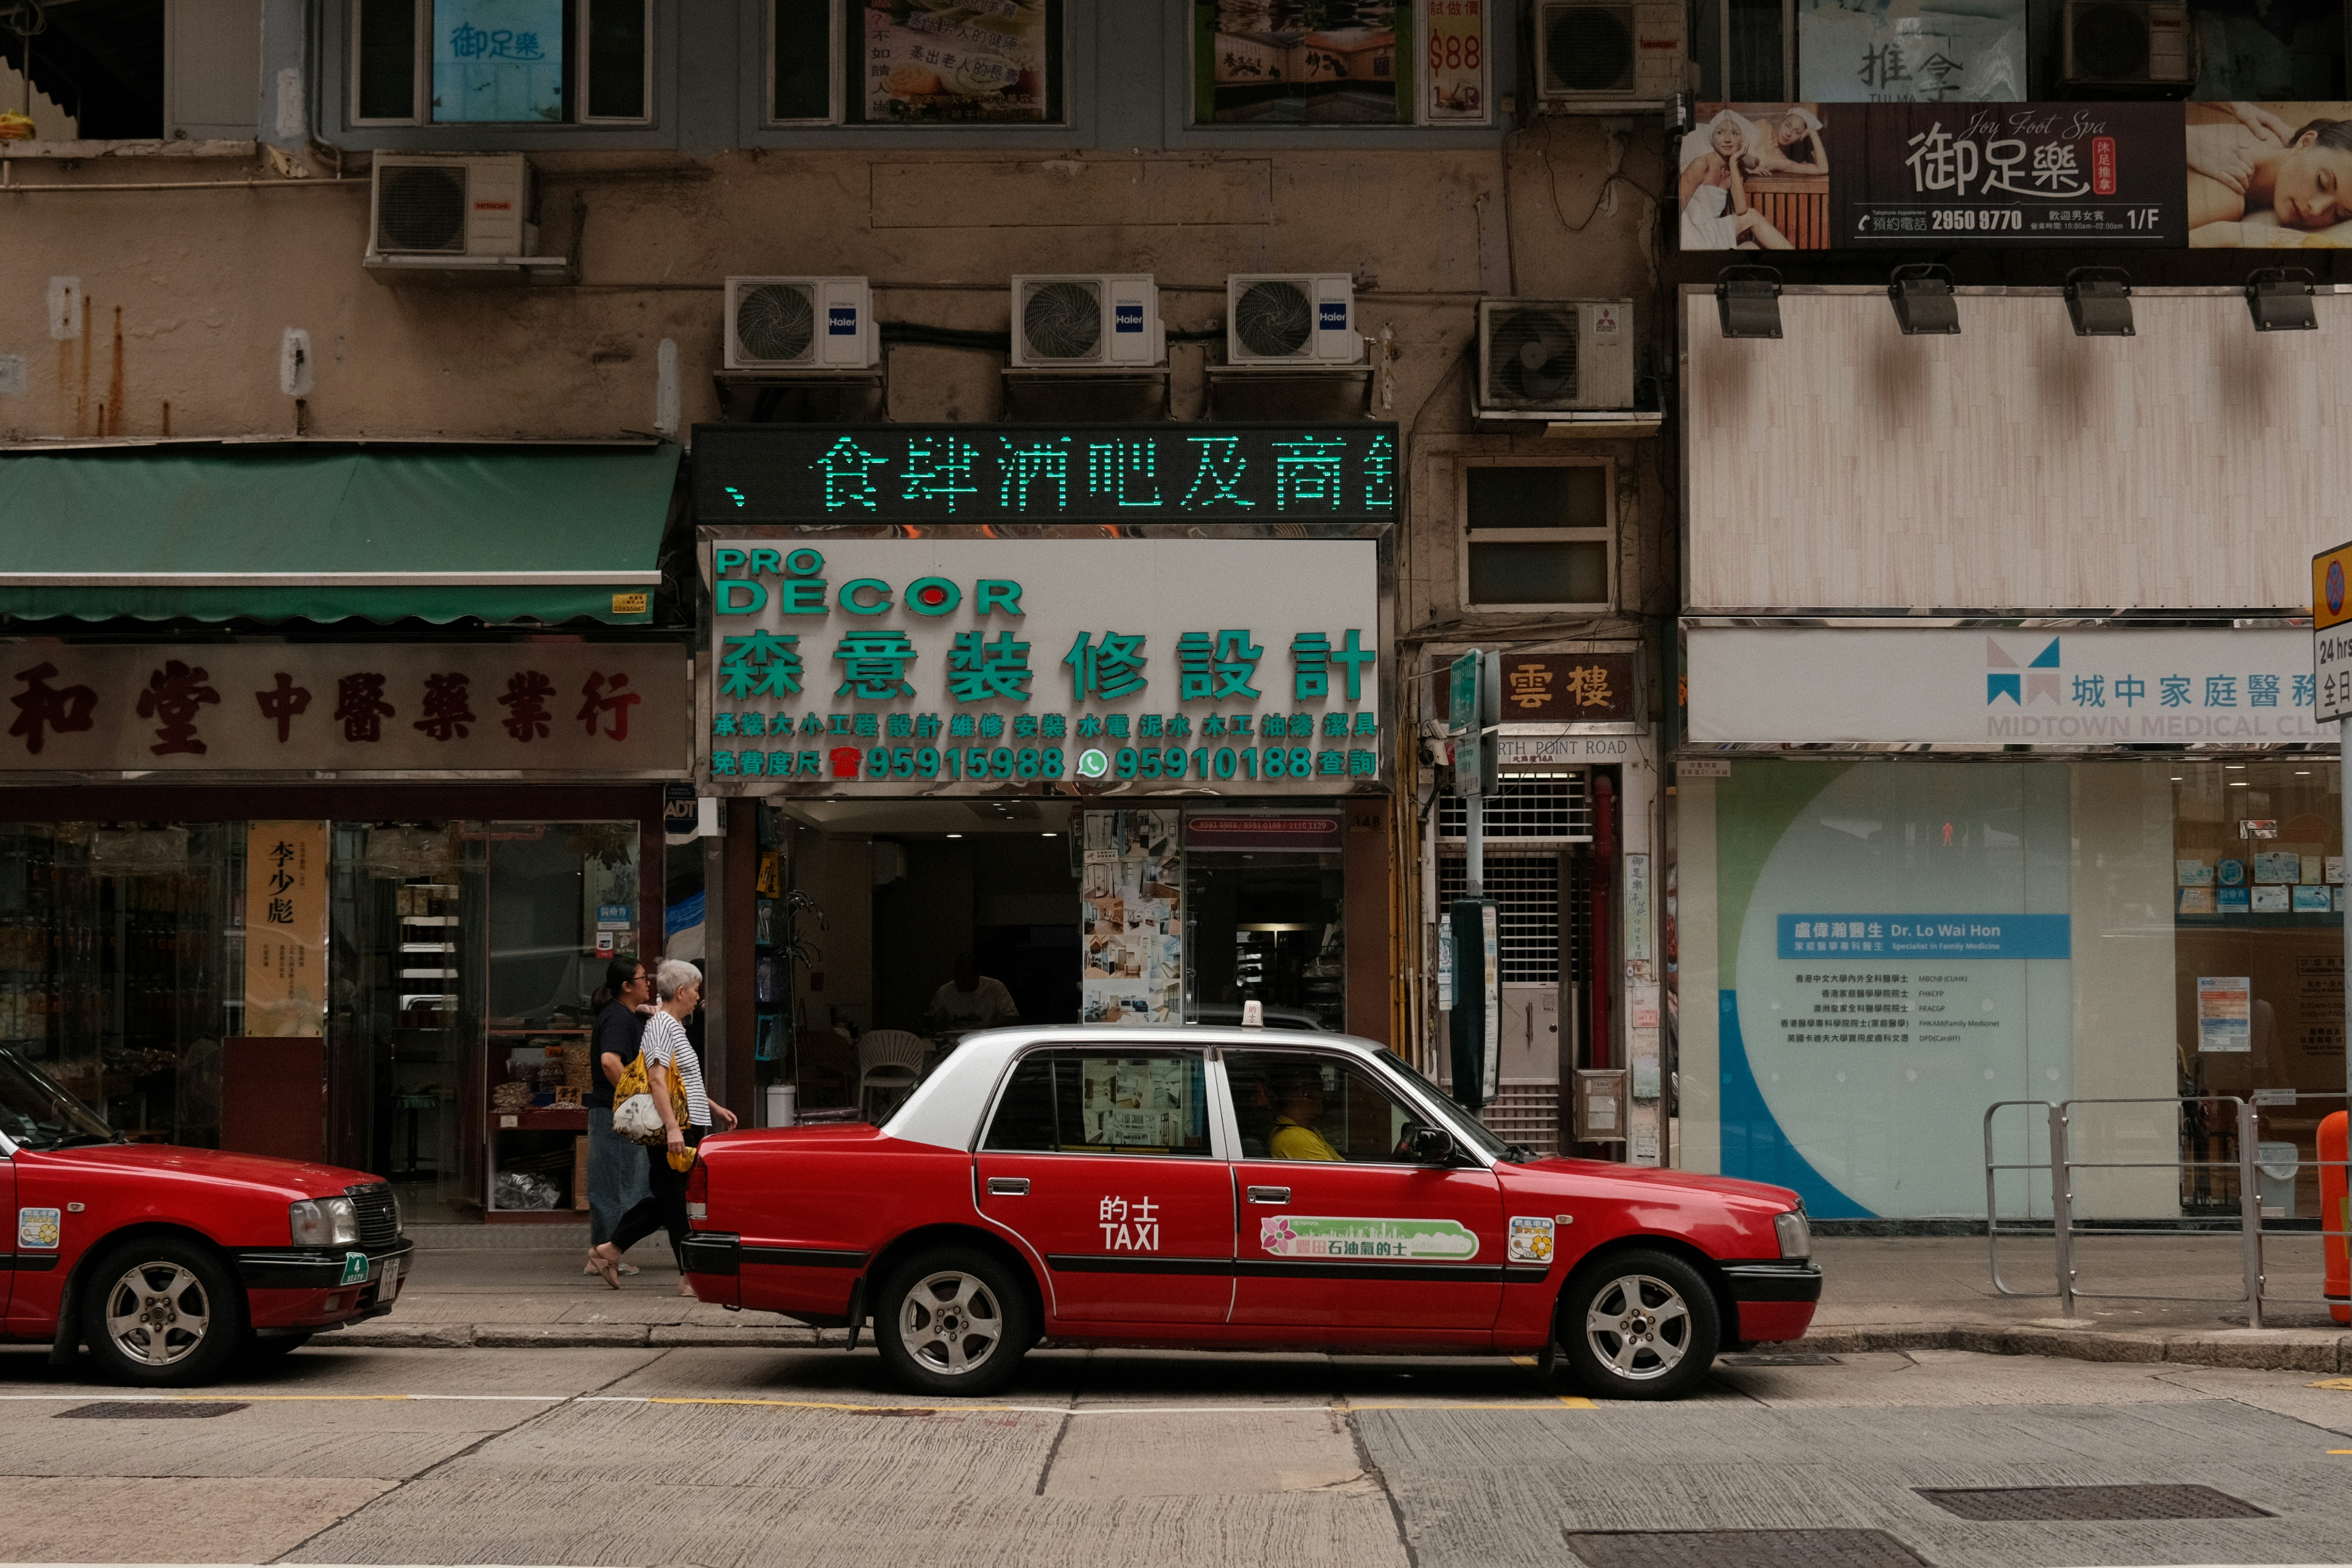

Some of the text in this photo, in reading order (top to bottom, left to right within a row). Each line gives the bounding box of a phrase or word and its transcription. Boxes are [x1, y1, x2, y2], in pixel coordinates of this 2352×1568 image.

[942, 0, 1017, 19] 人的美麗
[450, 21, 545, 61] 御足樂
[907, 11, 1018, 51] 蒸出男人的健康
[910, 45, 1020, 85] 蒸出老人的長壽
[1430, 29, 1480, 77] $88
[1957, 110, 2107, 144] Joy Foot Spa
[1905, 121, 2090, 198] 御足樂
[2097, 141, 2111, 190] 沐足推拿
[1873, 217, 1927, 231] 預約電話
[1932, 210, 2022, 230] 2950 9770
[2049, 210, 2104, 221] 歡迎男女賓
[2127, 209, 2159, 230] 1/F
[830, 318, 856, 327] Haier
[1116, 315, 1142, 324] Haier
[1320, 312, 1346, 322] Haier
[716, 548, 824, 576] PRO
[715, 576, 1026, 616] DECOR
[2320, 639, 2334, 665] 24
[718, 629, 1377, 703] 森意裝修設計
[1509, 664, 1613, 708] 雲樓
[2324, 671, 2350, 707] 全日
[8, 660, 642, 755] 和堂中醫藥業行
[714, 712, 1377, 738] 承接大小工程 設計 維修 安裝 水電 泥水 木工 油漆 潔具
[1988, 715, 2341, 738] MIDTOWN MEDICAL CLIN
[1498, 740, 1626, 755] RTH POINT ROAD
[712, 747, 1377, 778] 免費度尺 95915988 95910188 查詢
[664, 800, 697, 818] ADT
[1219, 821, 1237, 830] 5988
[267, 841, 295, 924] 李少彪
[1795, 922, 2000, 938] 盧偉瀚醫生 Dr. Lo Wai Hon
[1795, 942, 1883, 951] 家庭醫學專科醫生
[1099, 1195, 1159, 1222] 的士
[1099, 1223, 1159, 1251] TAXI
[1296, 1239, 1407, 1256] 豐田石油氣的士
[347, 1274, 363, 1282] SEATS
[354, 1259, 360, 1273] 4
